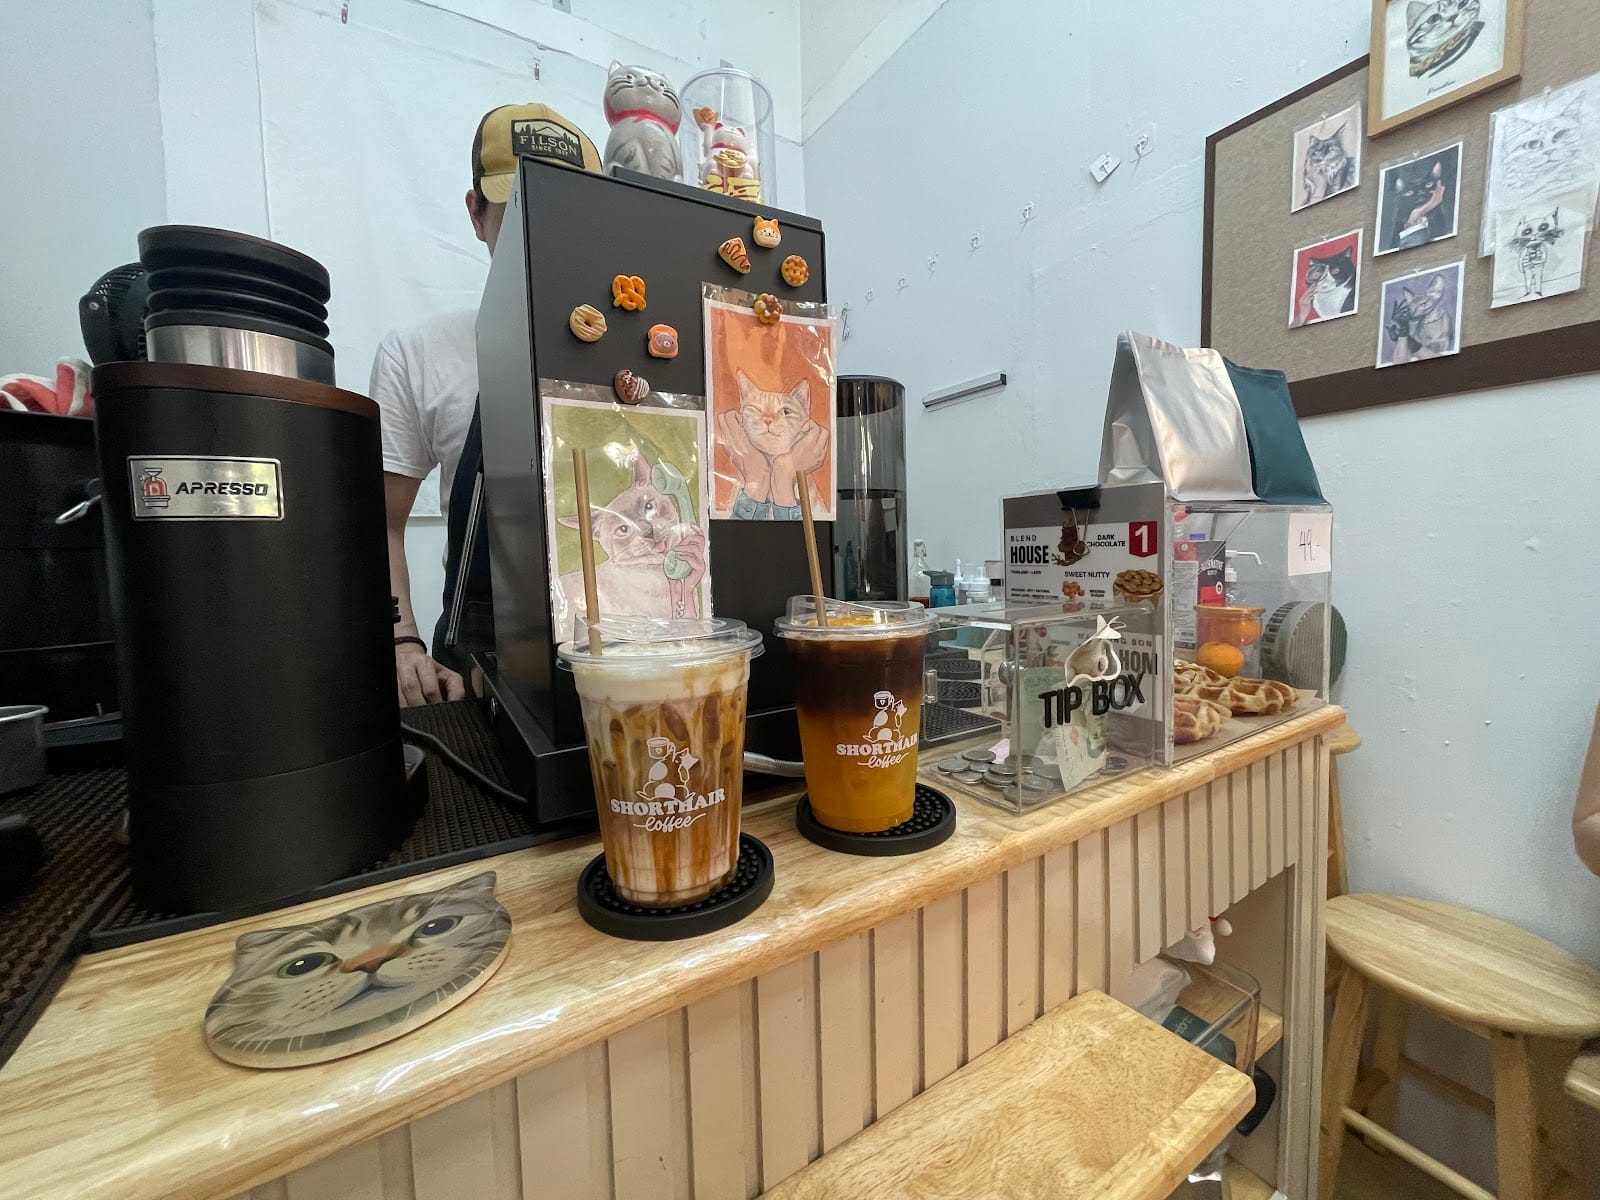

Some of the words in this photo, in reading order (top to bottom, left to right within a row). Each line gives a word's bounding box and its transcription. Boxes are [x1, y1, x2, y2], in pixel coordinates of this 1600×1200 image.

[520, 135, 577, 156] FILSON
[175, 481, 268, 496] APRESSO
[1010, 534, 1037, 542] BLEND
[1134, 524, 1149, 553] 1
[1010, 545, 1049, 564] HOUSE
[1038, 685, 1083, 728] TIP
[1092, 672, 1146, 716] BOX
[857, 752, 909, 768] Coffee
[610, 788, 725, 816] SHORTHAIR
[633, 813, 707, 833] Coffee
